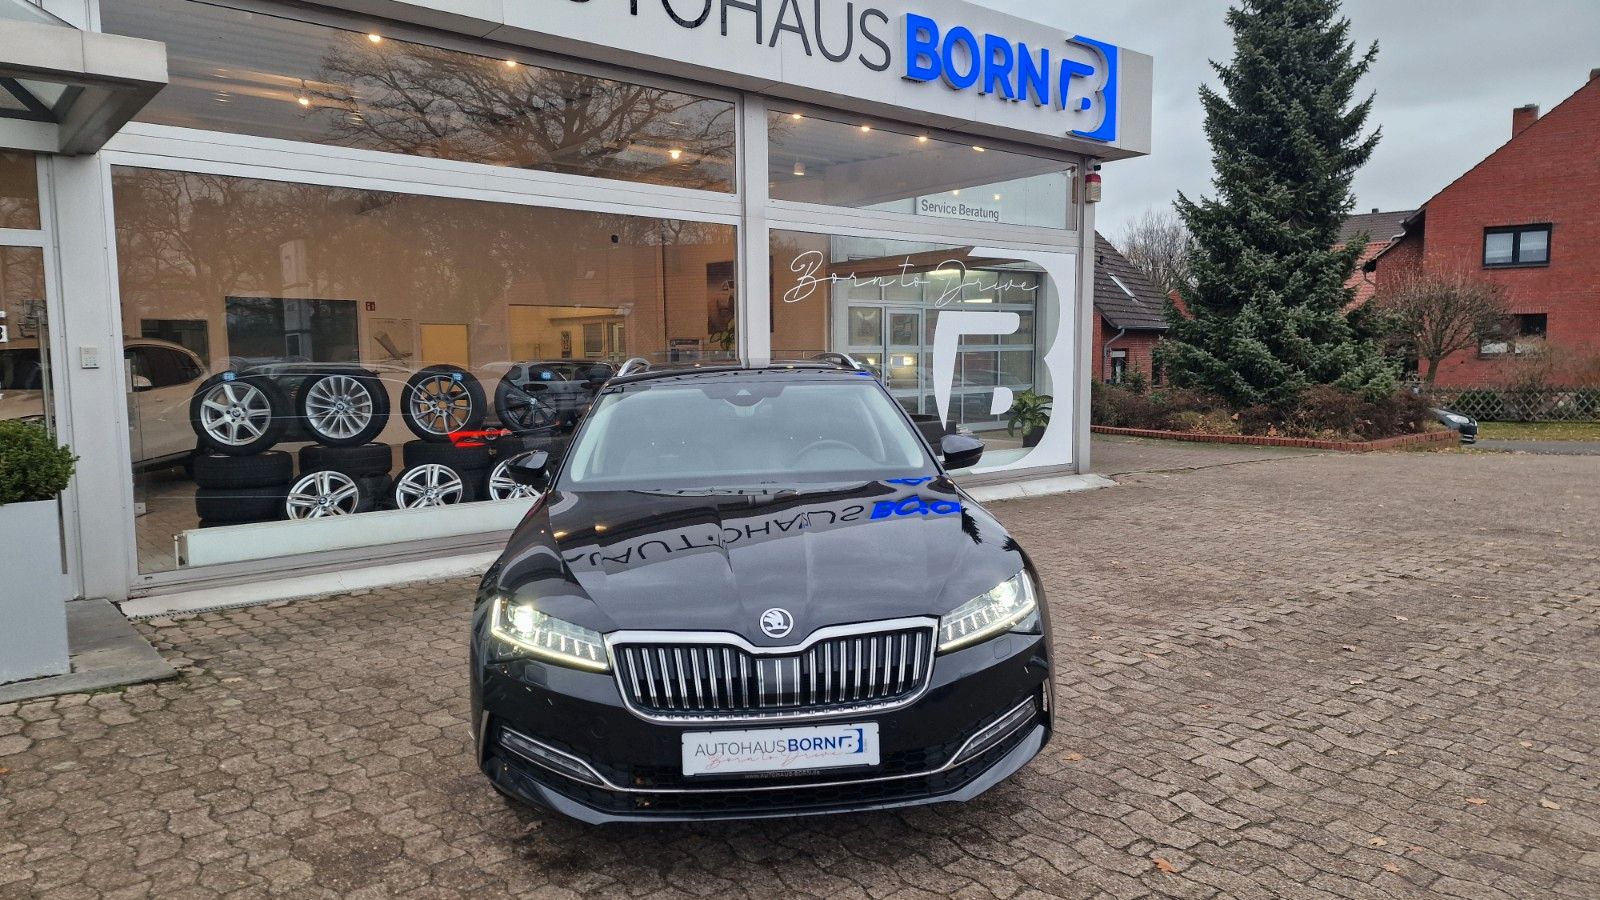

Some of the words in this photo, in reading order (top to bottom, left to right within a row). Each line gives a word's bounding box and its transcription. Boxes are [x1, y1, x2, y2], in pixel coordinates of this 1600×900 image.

[901, 13, 1049, 106] BORN
[921, 199, 957, 215] Service
[959, 203, 1000, 222] Beratung
[784, 250, 896, 303] Born
[898, 255, 930, 288] to
[935, 259, 1039, 308] Drive
[788, 736, 836, 752] BORN
